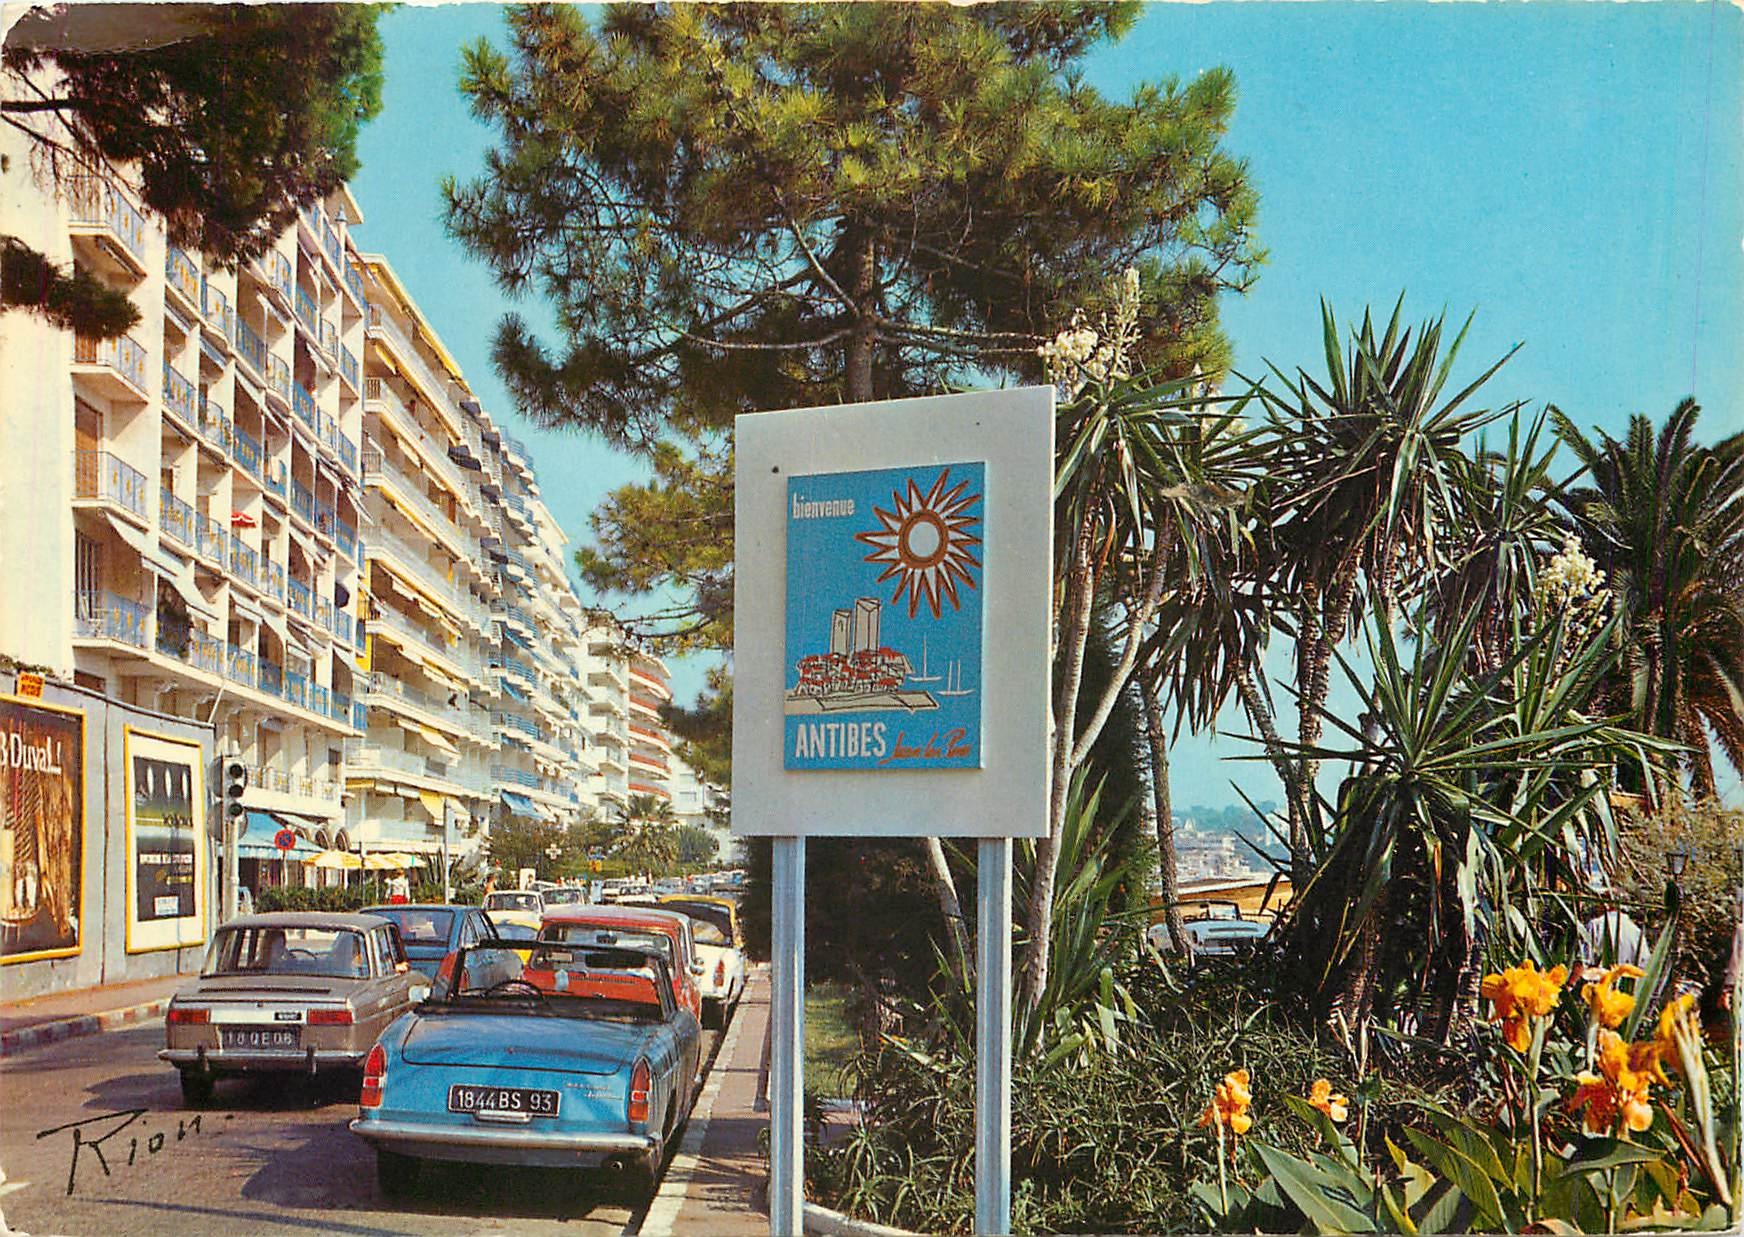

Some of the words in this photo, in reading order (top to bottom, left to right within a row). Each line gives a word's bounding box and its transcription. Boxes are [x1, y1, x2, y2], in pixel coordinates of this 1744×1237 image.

[793, 492, 855, 519] bienvenue
[795, 721, 887, 759] ANTIBES
[530, 1093, 552, 1111] 93
